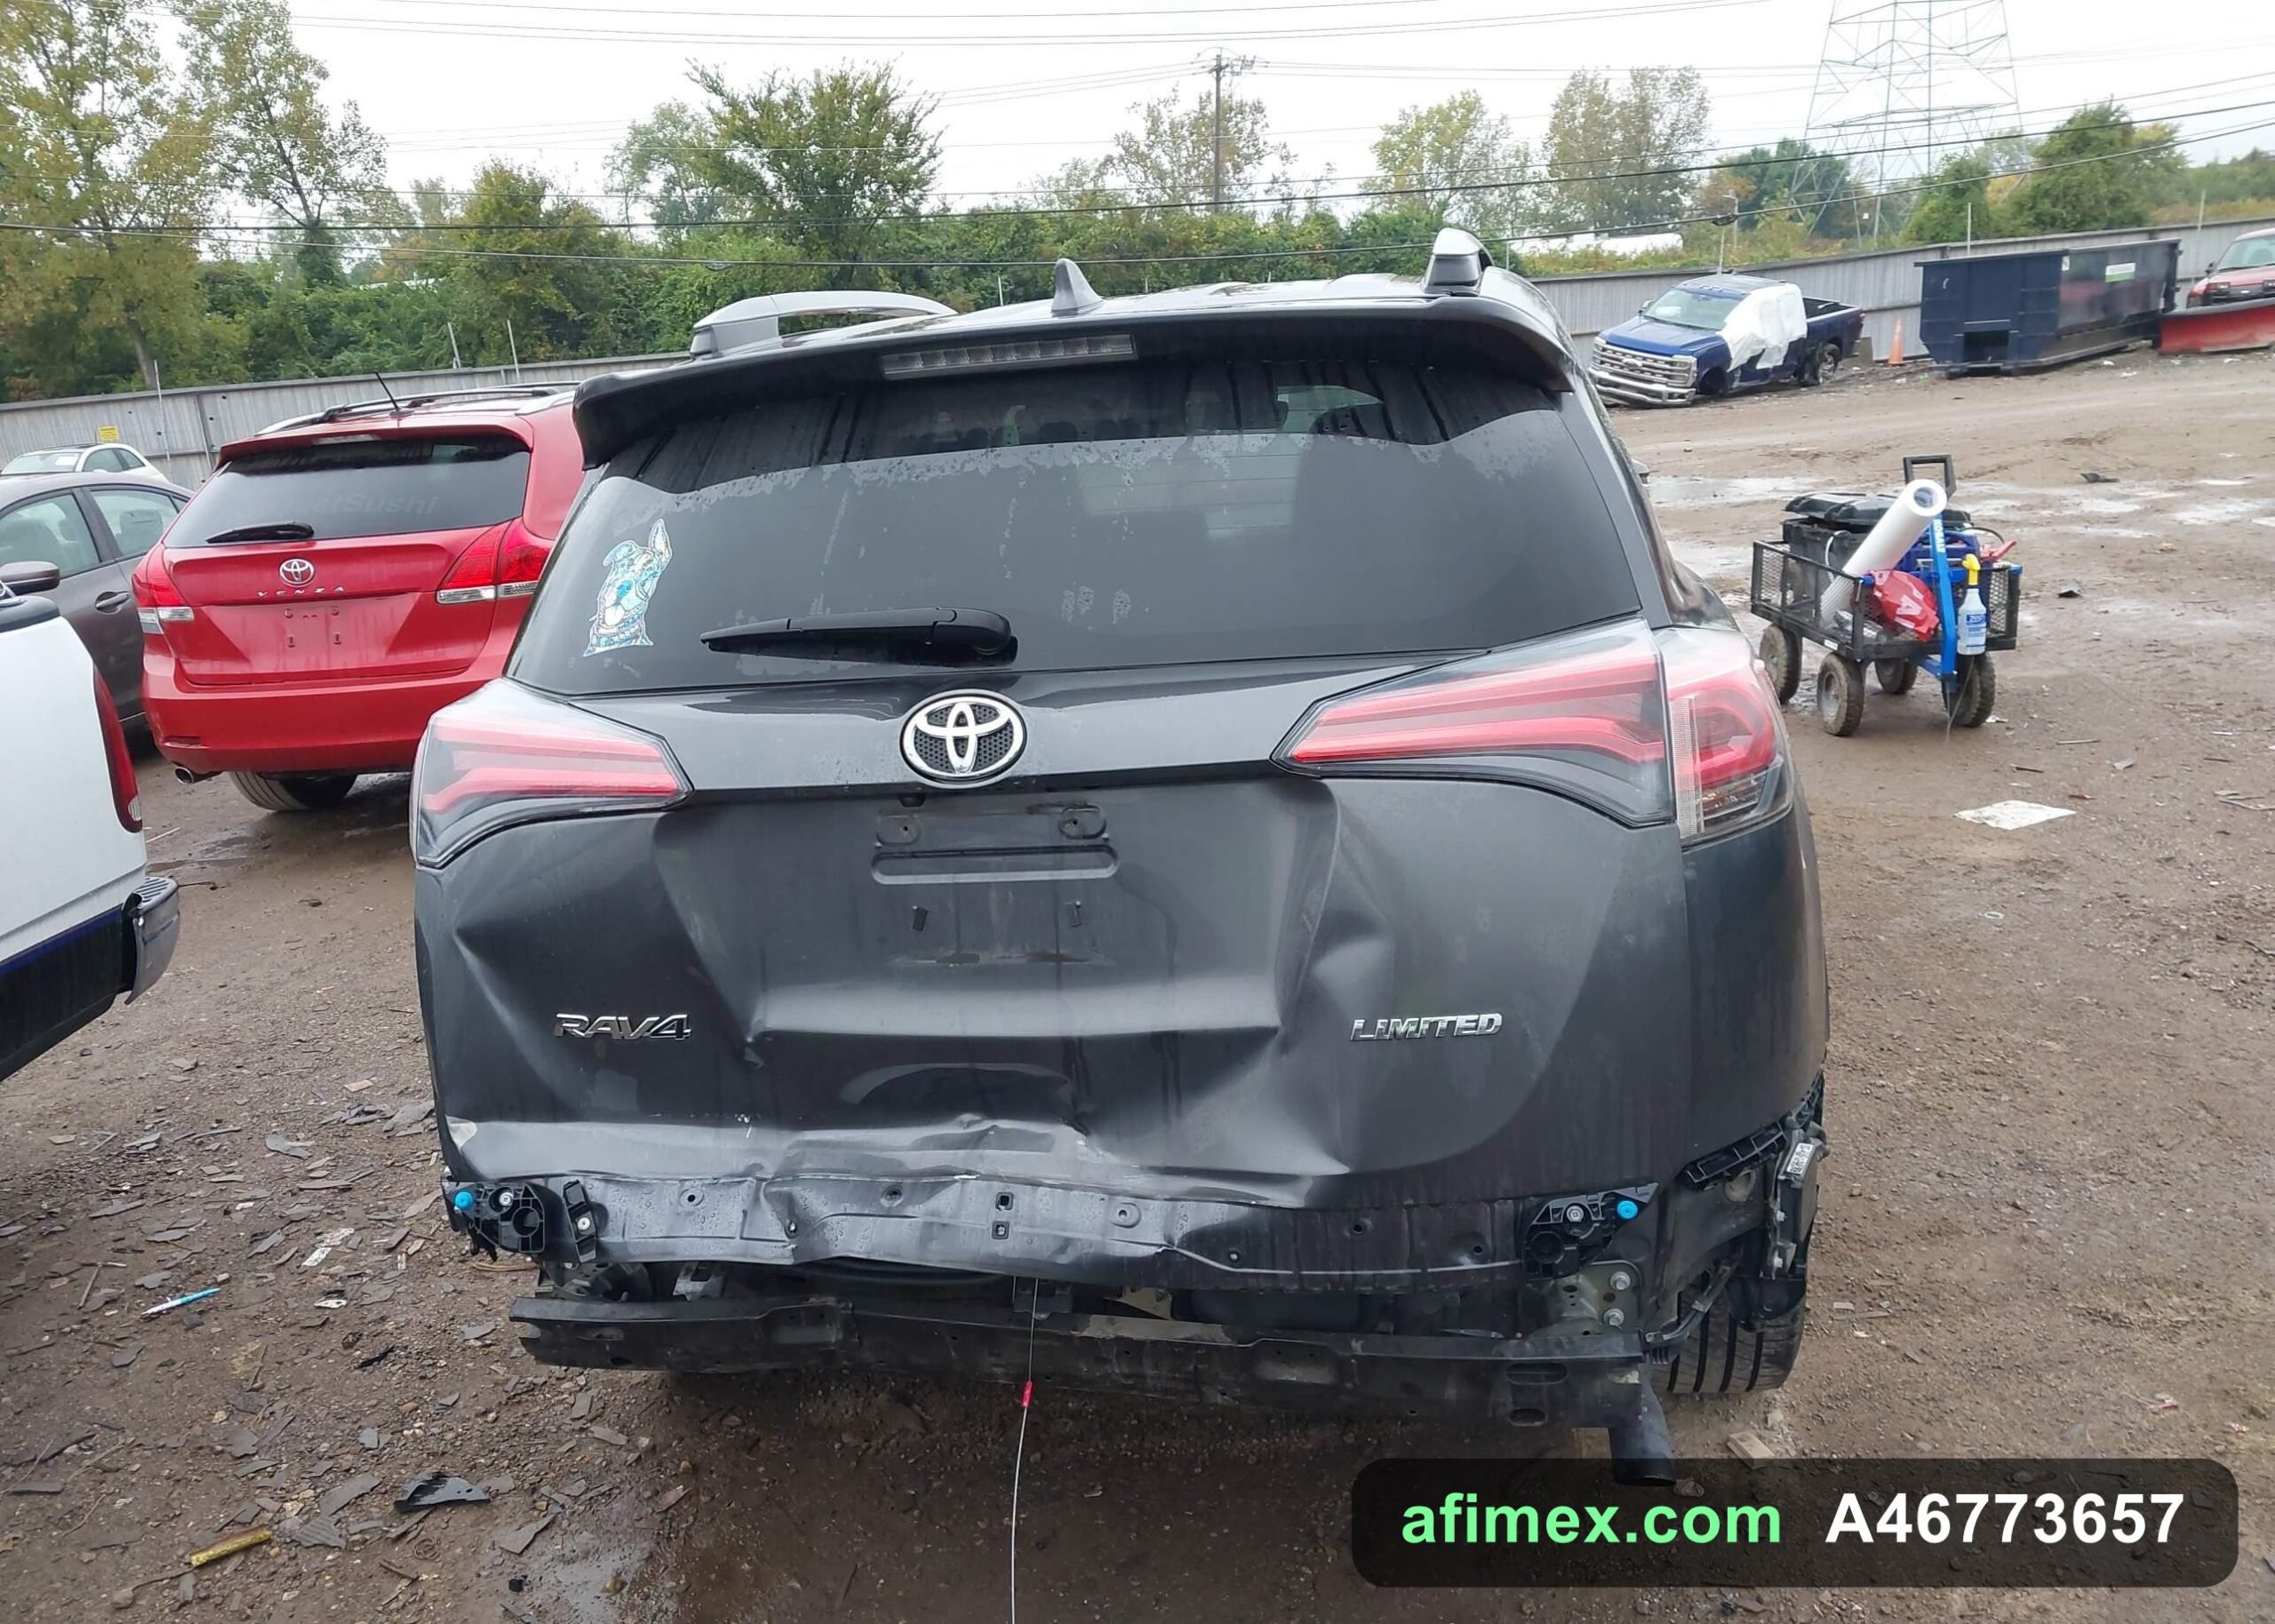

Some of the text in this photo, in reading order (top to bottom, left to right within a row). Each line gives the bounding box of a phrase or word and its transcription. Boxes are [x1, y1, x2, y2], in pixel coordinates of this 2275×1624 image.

[257, 585, 346, 597] VENZA
[553, 1013, 692, 1040] RAV4
[1350, 1013, 1503, 1041] LIMITED
